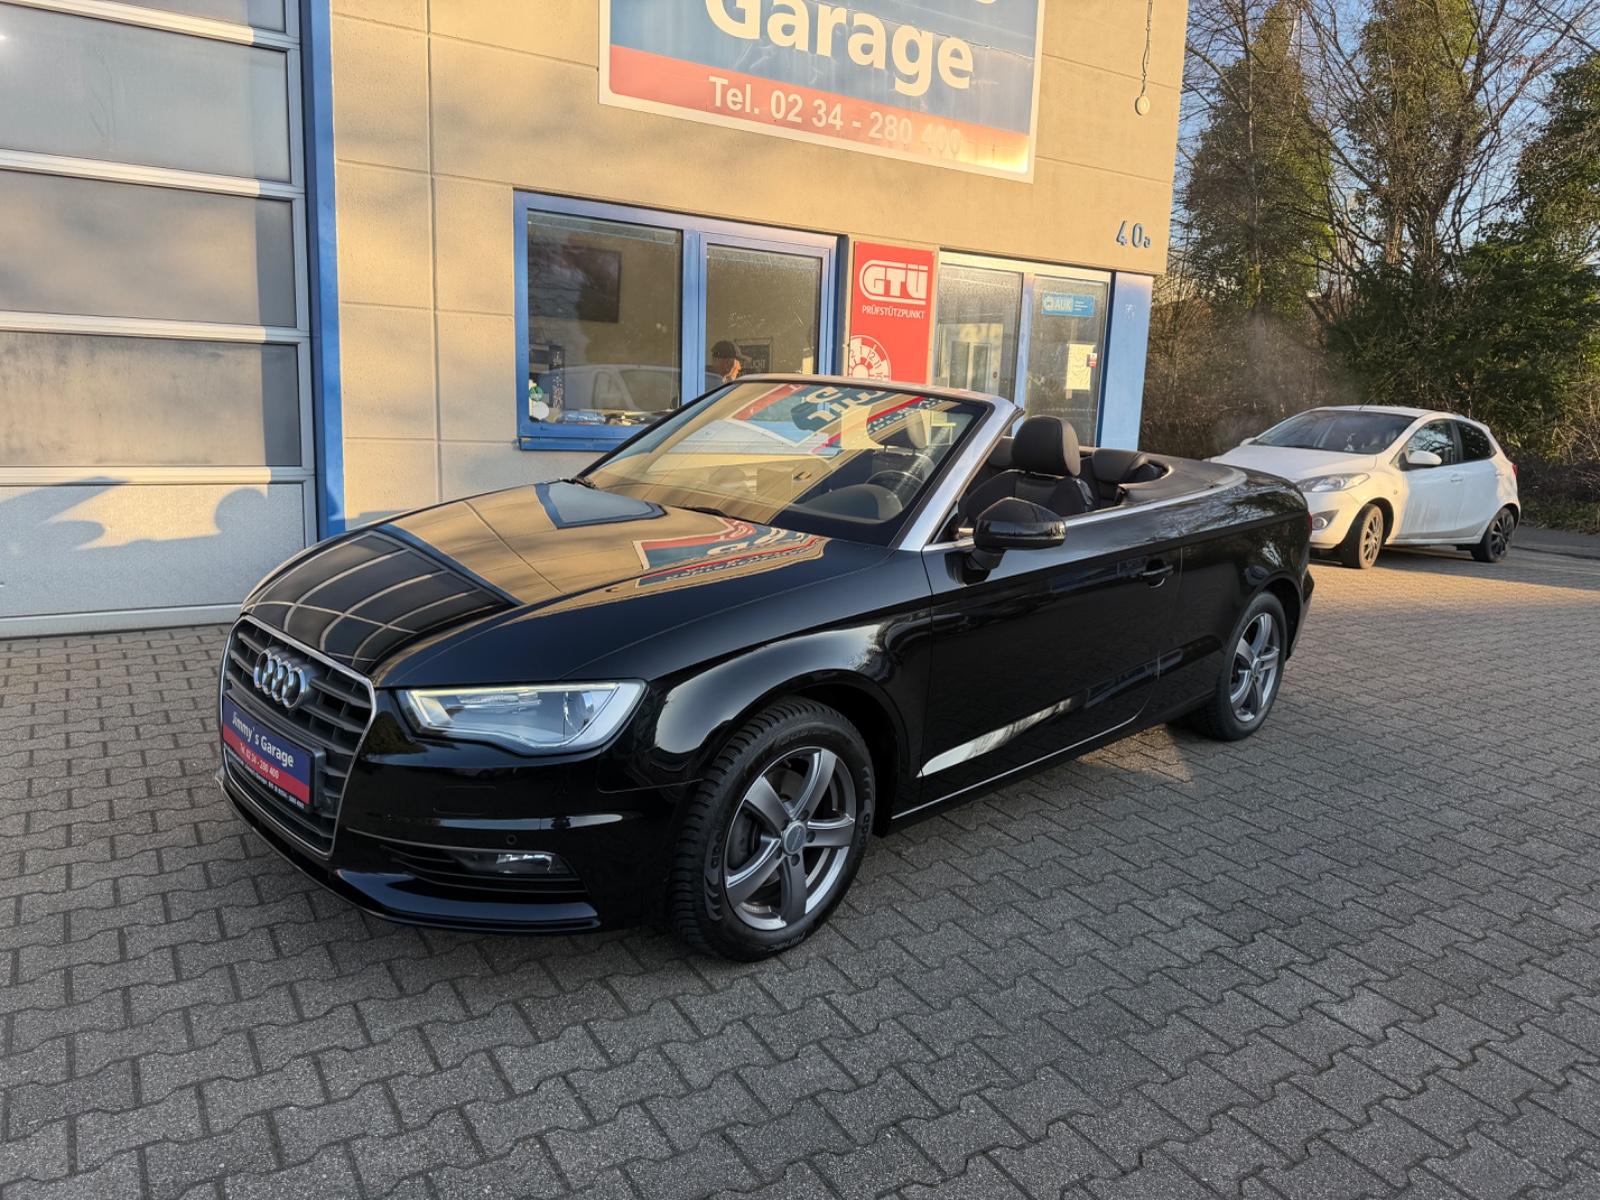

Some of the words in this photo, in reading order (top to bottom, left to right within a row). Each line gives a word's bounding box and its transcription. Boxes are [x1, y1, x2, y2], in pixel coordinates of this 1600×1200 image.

[705, 0, 974, 96] Garage
[708, 75, 760, 115] Tel.
[770, 89, 803, 124] 02
[811, 99, 844, 131] 34
[868, 111, 913, 144] 280
[921, 122, 963, 157] 400
[860, 259, 928, 305] GTÜ
[862, 304, 925, 319] PRÜFSTÜTZPUNKT
[261, 736, 294, 768] Garage
